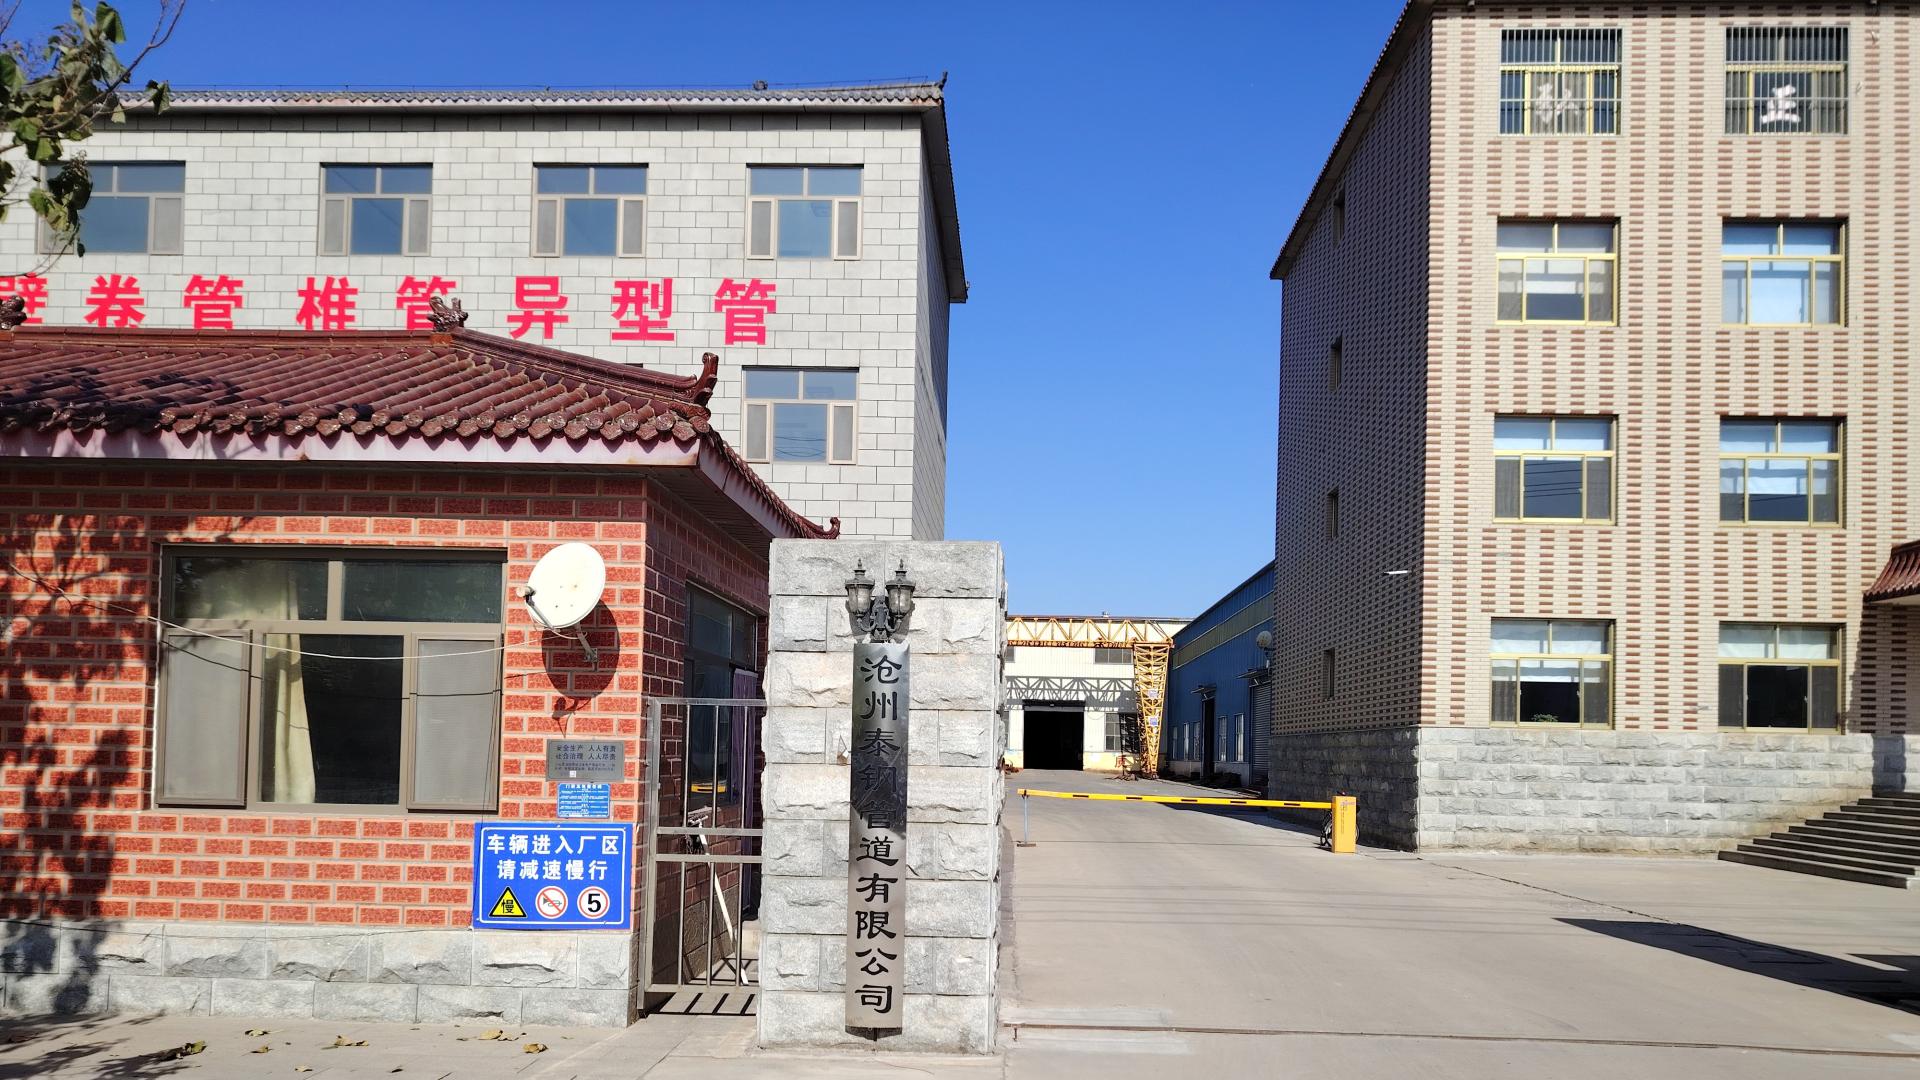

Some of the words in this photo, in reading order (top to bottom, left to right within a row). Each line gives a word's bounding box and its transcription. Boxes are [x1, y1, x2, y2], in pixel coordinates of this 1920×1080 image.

[487, 833, 619, 855] 车辆进入厂区
[855, 654, 902, 1014] 沧州泰钢管道有限公司
[497, 859, 608, 881] 请减速慢行
[501, 898, 514, 914] 慢
[587, 893, 602, 913] 5
